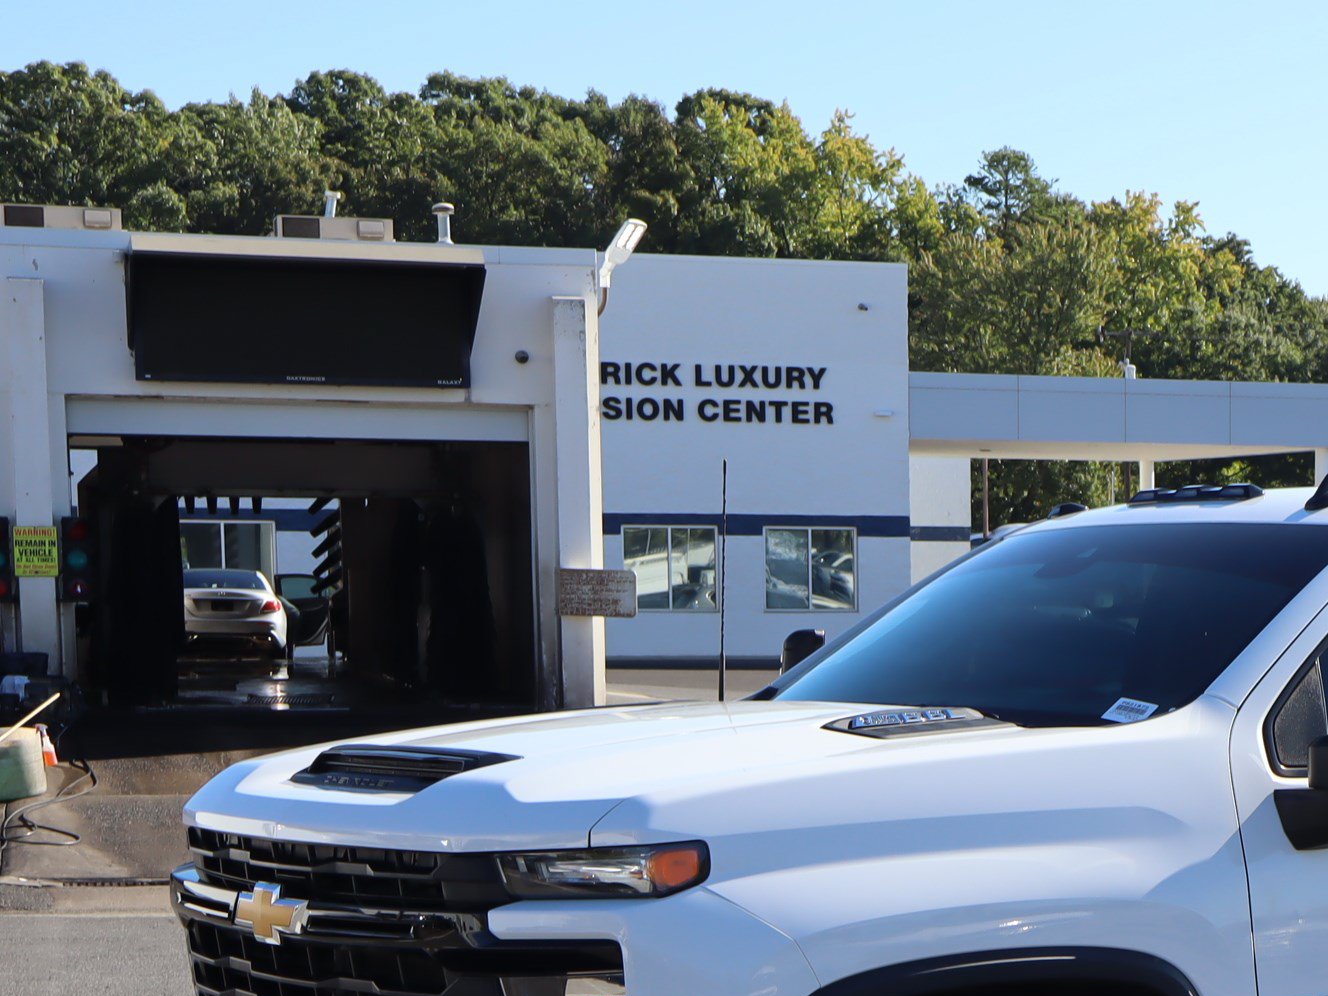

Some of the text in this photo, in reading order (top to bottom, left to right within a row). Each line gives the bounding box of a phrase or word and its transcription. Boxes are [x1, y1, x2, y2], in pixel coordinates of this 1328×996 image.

[601, 362, 827, 389] RICK LUXURY
[602, 397, 834, 424] SION CENTER
[18, 549, 52, 557] VEHICLE
